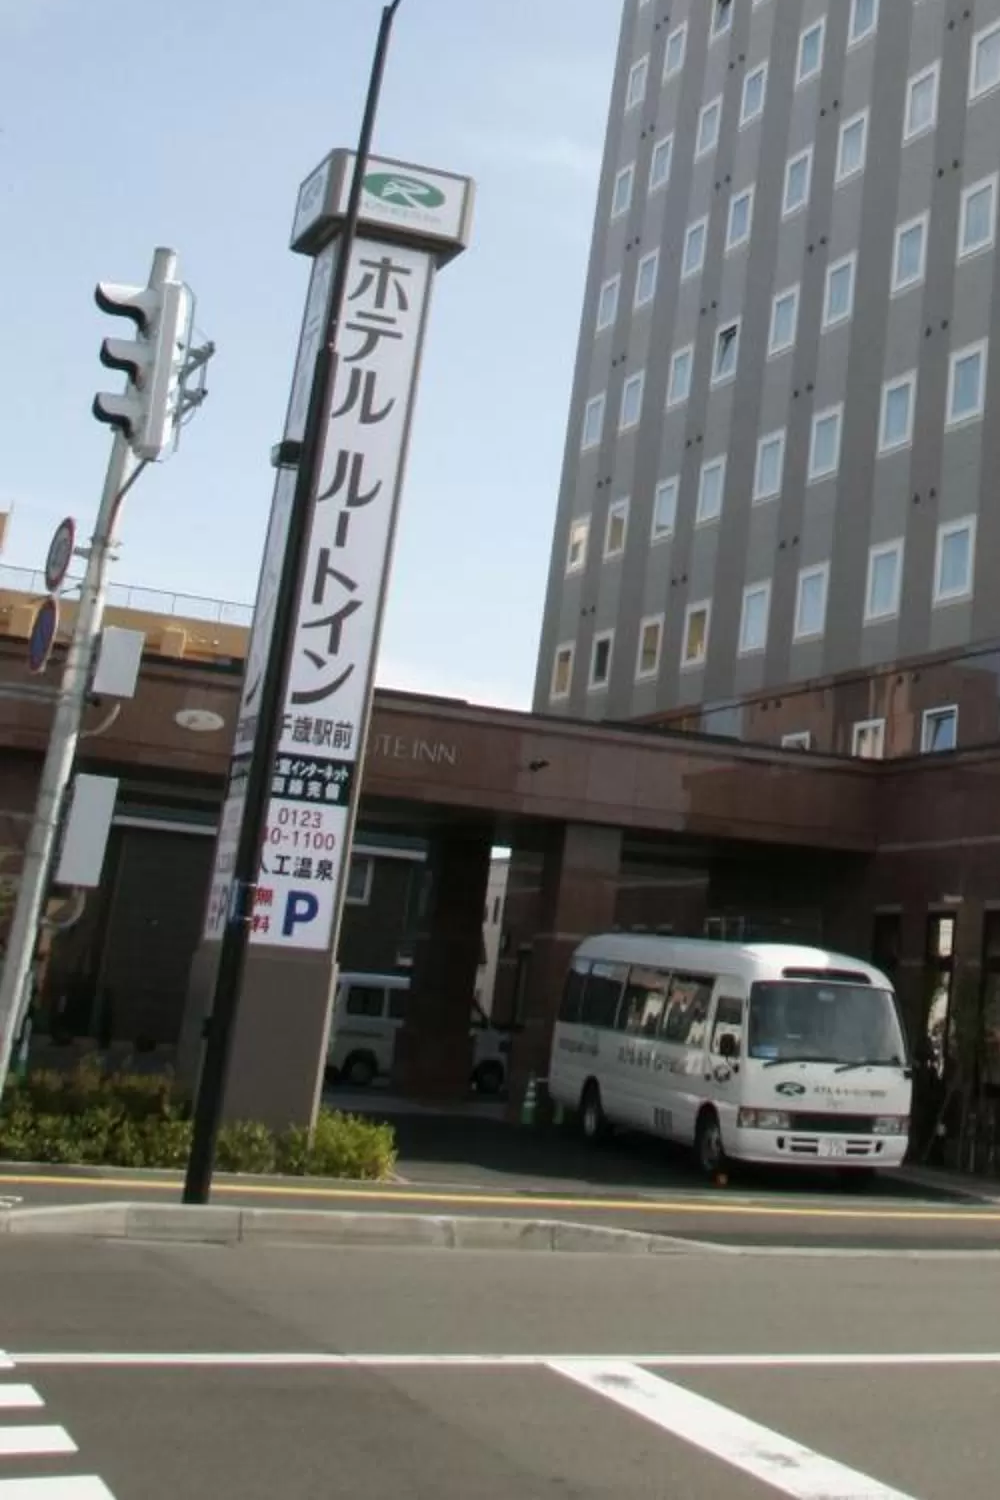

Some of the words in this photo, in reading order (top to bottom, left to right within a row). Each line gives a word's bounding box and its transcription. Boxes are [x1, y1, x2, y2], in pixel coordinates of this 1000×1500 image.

[331, 256, 412, 425] ホテル
[290, 448, 383, 706] ルートイン
[274, 758, 349, 781] 室インターネット
[412, 738, 457, 765] INN
[278, 807, 323, 830] 0123
[282, 890, 320, 937] P
